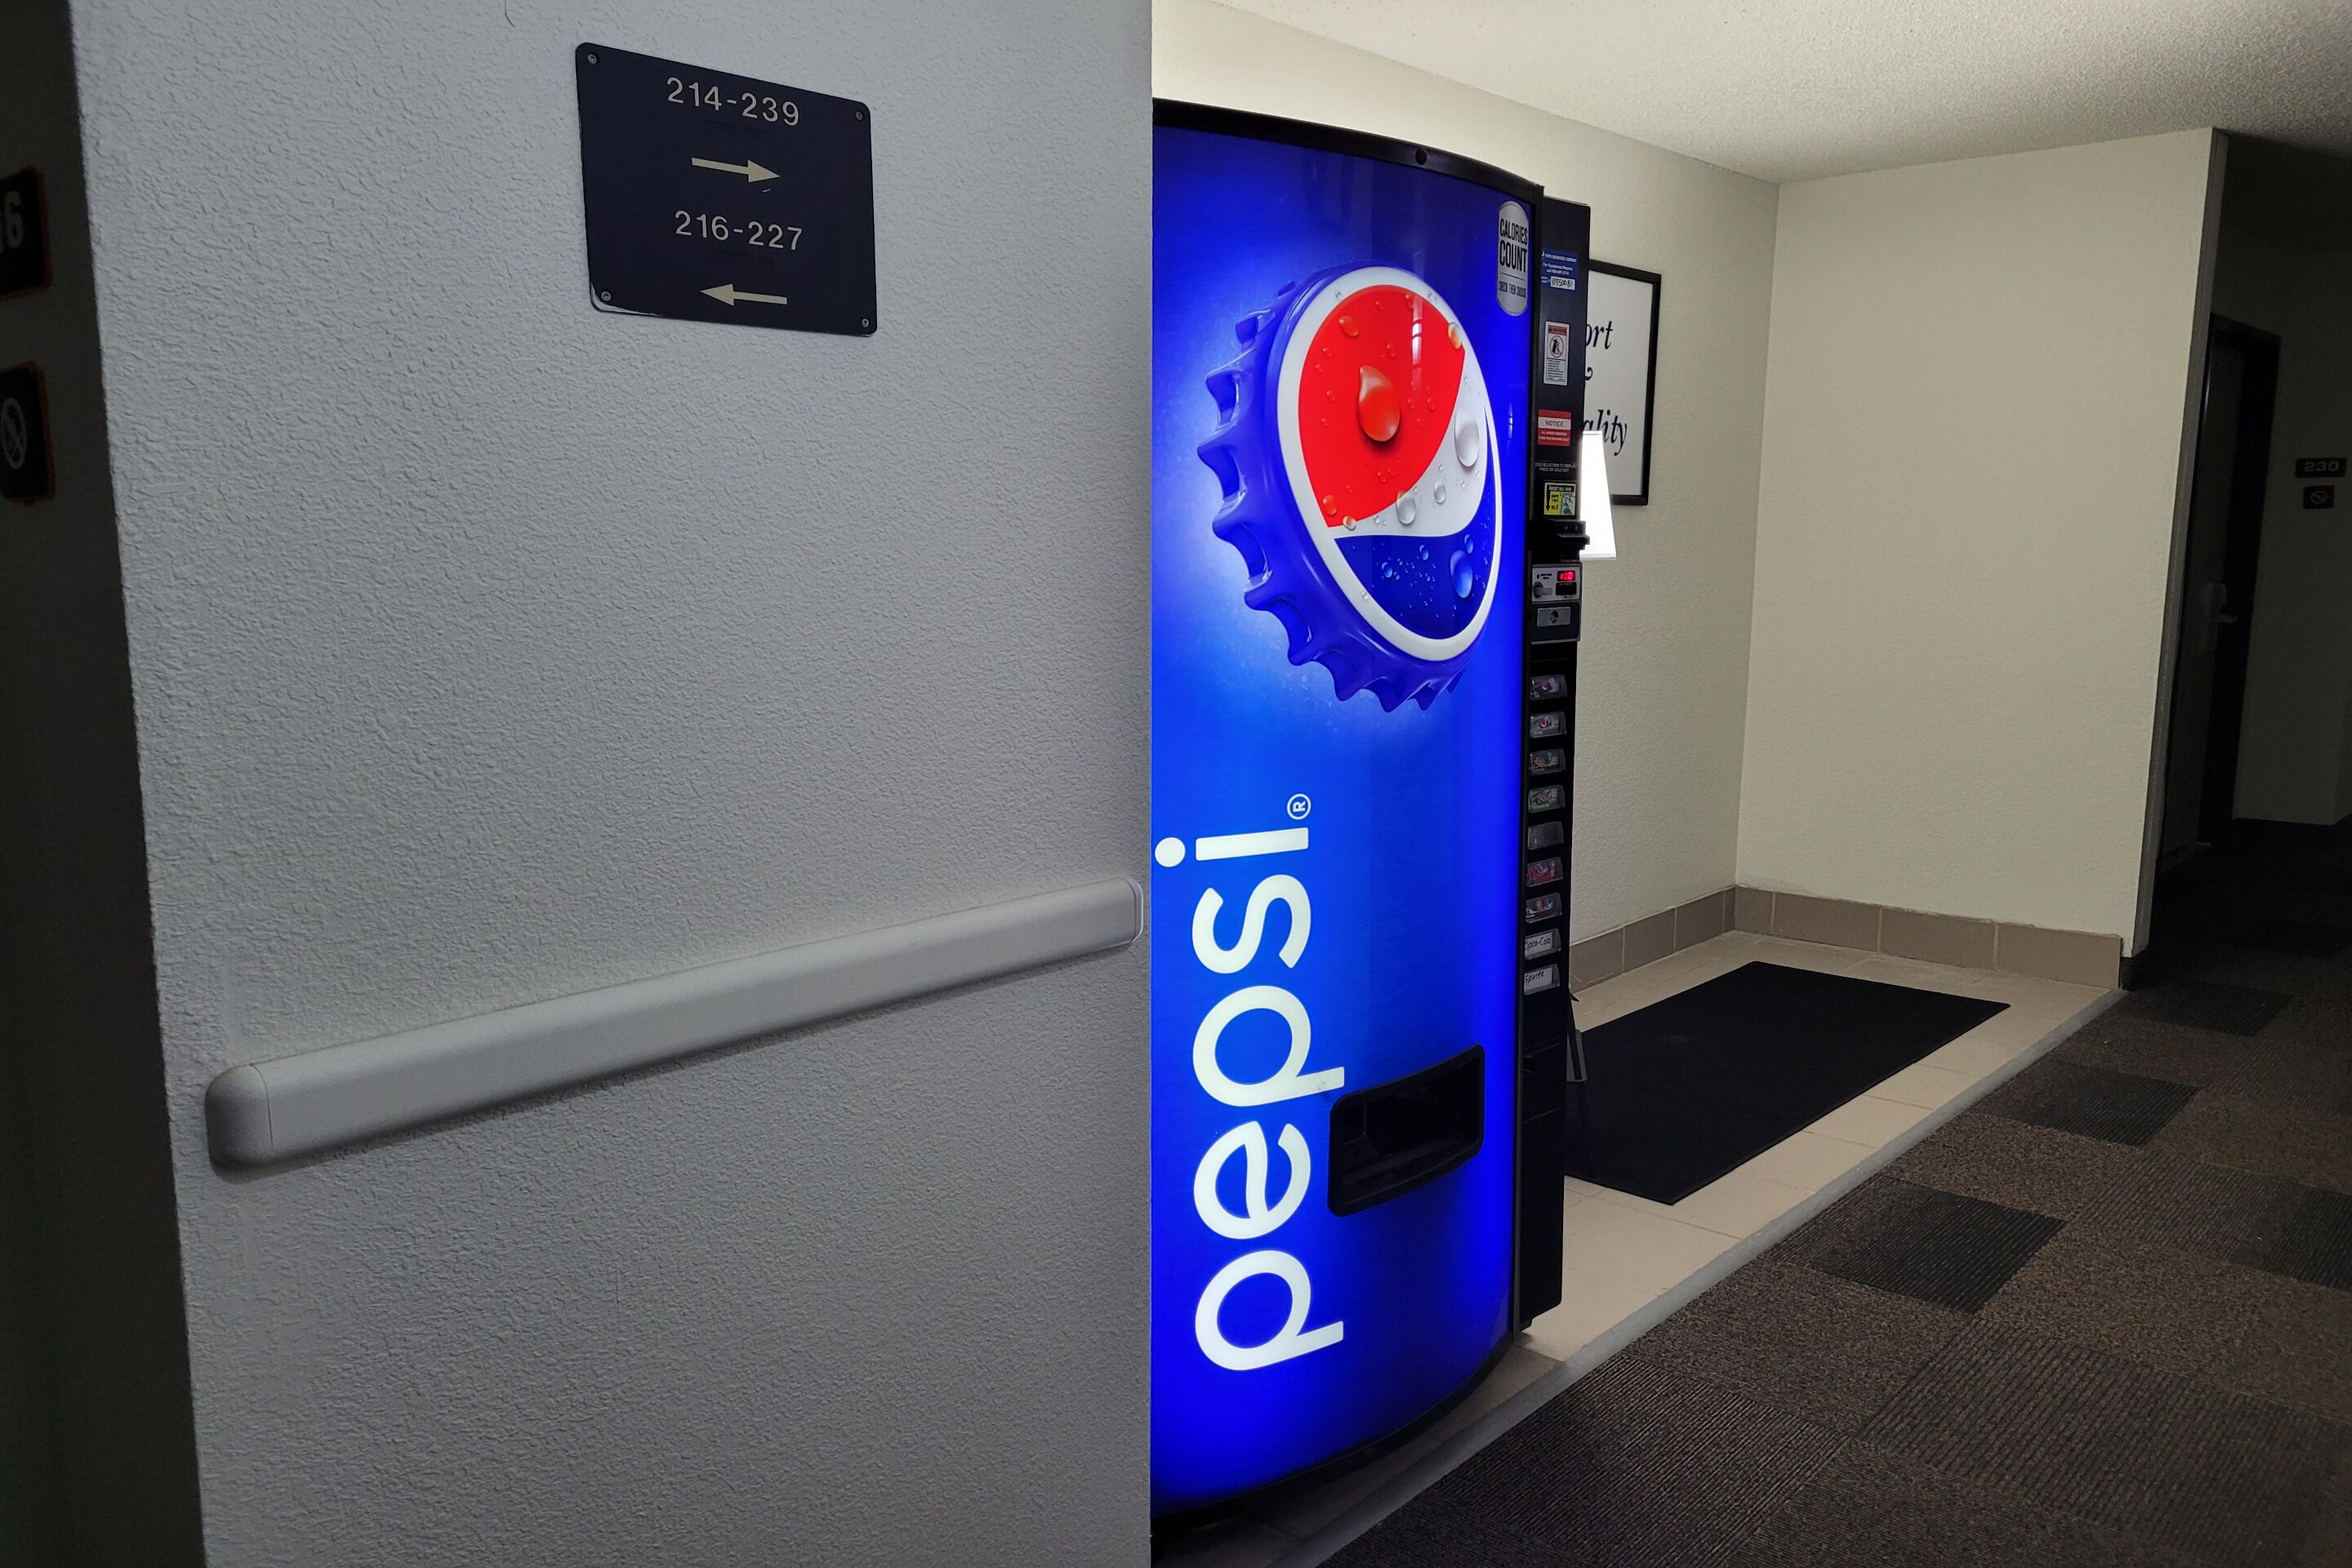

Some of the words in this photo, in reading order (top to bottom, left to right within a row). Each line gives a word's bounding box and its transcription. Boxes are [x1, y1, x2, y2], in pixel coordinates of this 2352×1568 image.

[666, 77, 800, 126] 214-239
[0, 189, 24, 251] 6
[675, 210, 803, 251] 216-227
[1499, 218, 1528, 246] CALORIES
[1499, 239, 1527, 273] COUNT
[1155, 827, 1344, 1371] pepsi
